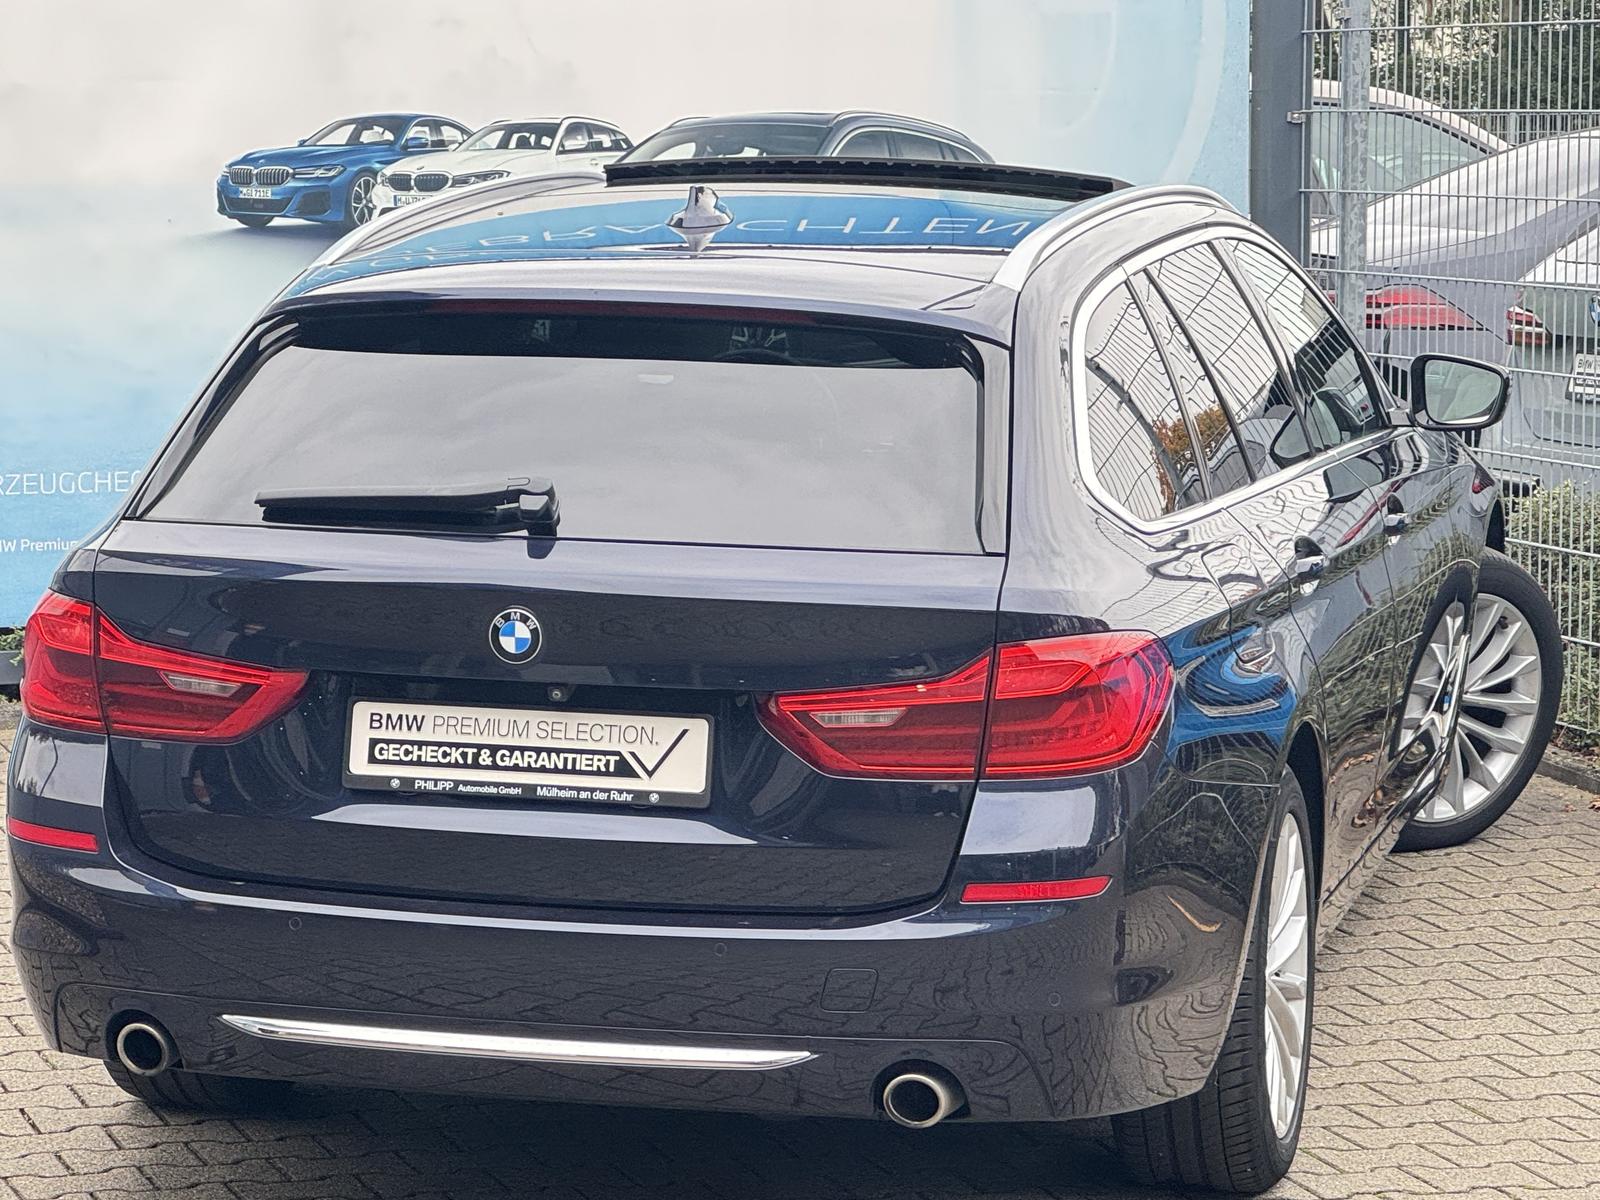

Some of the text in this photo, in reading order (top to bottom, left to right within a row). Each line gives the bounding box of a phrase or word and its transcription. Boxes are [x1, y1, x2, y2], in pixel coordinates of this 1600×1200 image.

[1577, 358, 1594, 369] BW
[0, 538, 17, 552] W
[495, 611, 537, 630] BMW
[369, 712, 659, 746] BMW PREMIUM SELECTION.
[374, 743, 477, 764] GECHECKT
[495, 749, 620, 772] GARANTIERT
[414, 779, 633, 802] PHILIPP Automobile GmbH Mülheim an der Ruhr
